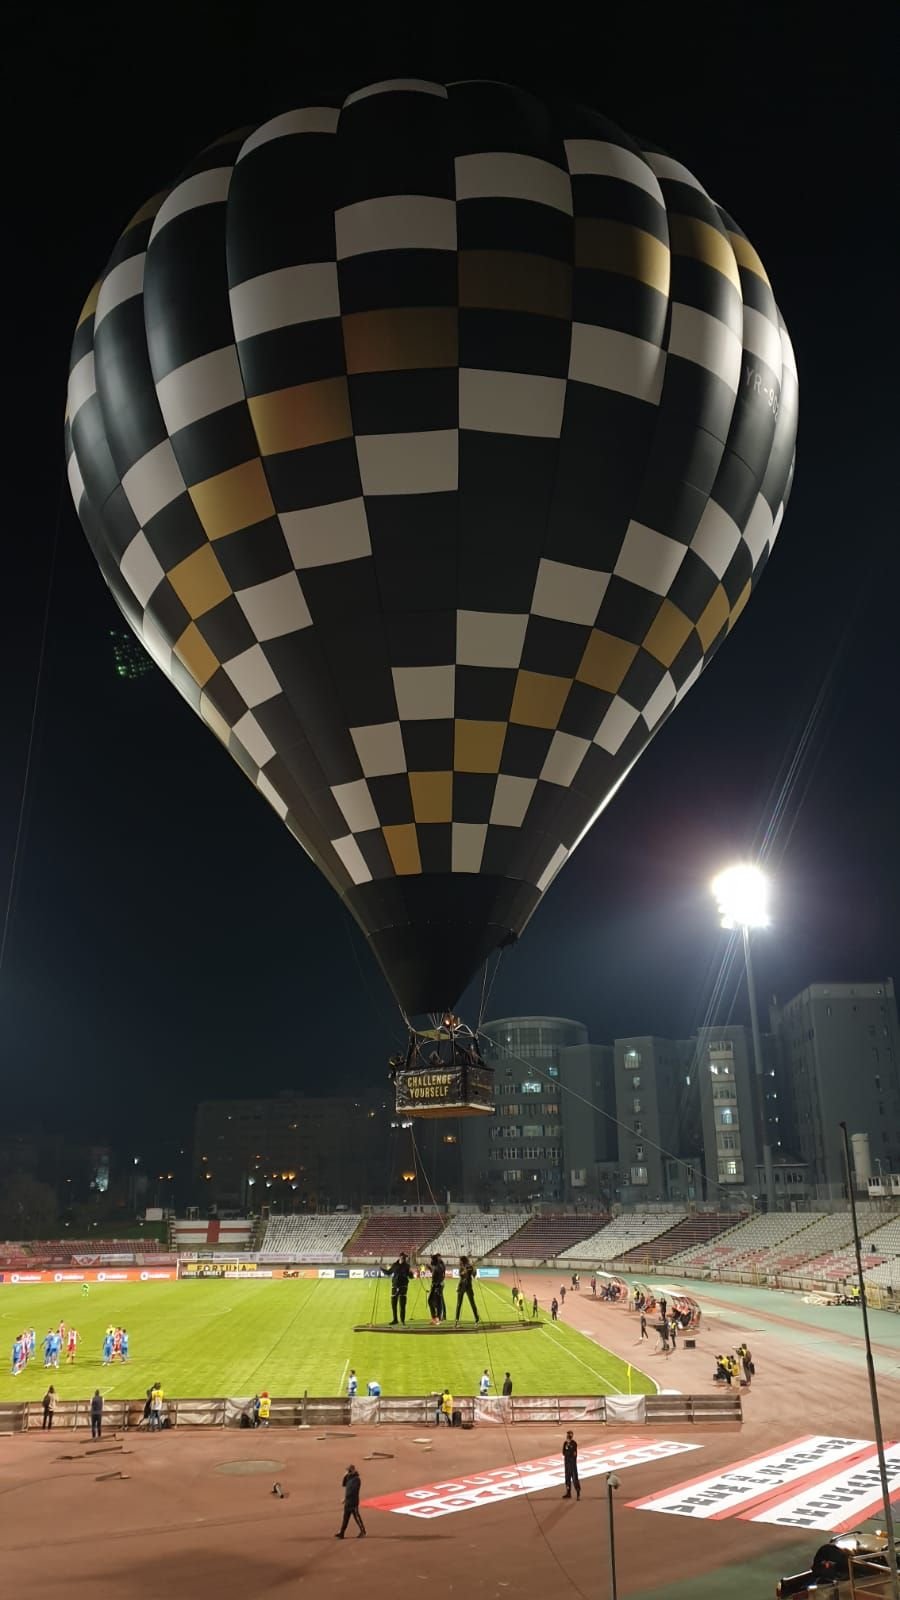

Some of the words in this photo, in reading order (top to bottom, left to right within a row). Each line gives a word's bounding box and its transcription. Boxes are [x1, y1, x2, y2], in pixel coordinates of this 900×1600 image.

[407, 1074, 453, 1088] CHALLENGE
[410, 1086, 449, 1099] YOURSELF
[197, 1264, 247, 1272] FORTUNA
[409, 1482, 535, 1515] DOAR
